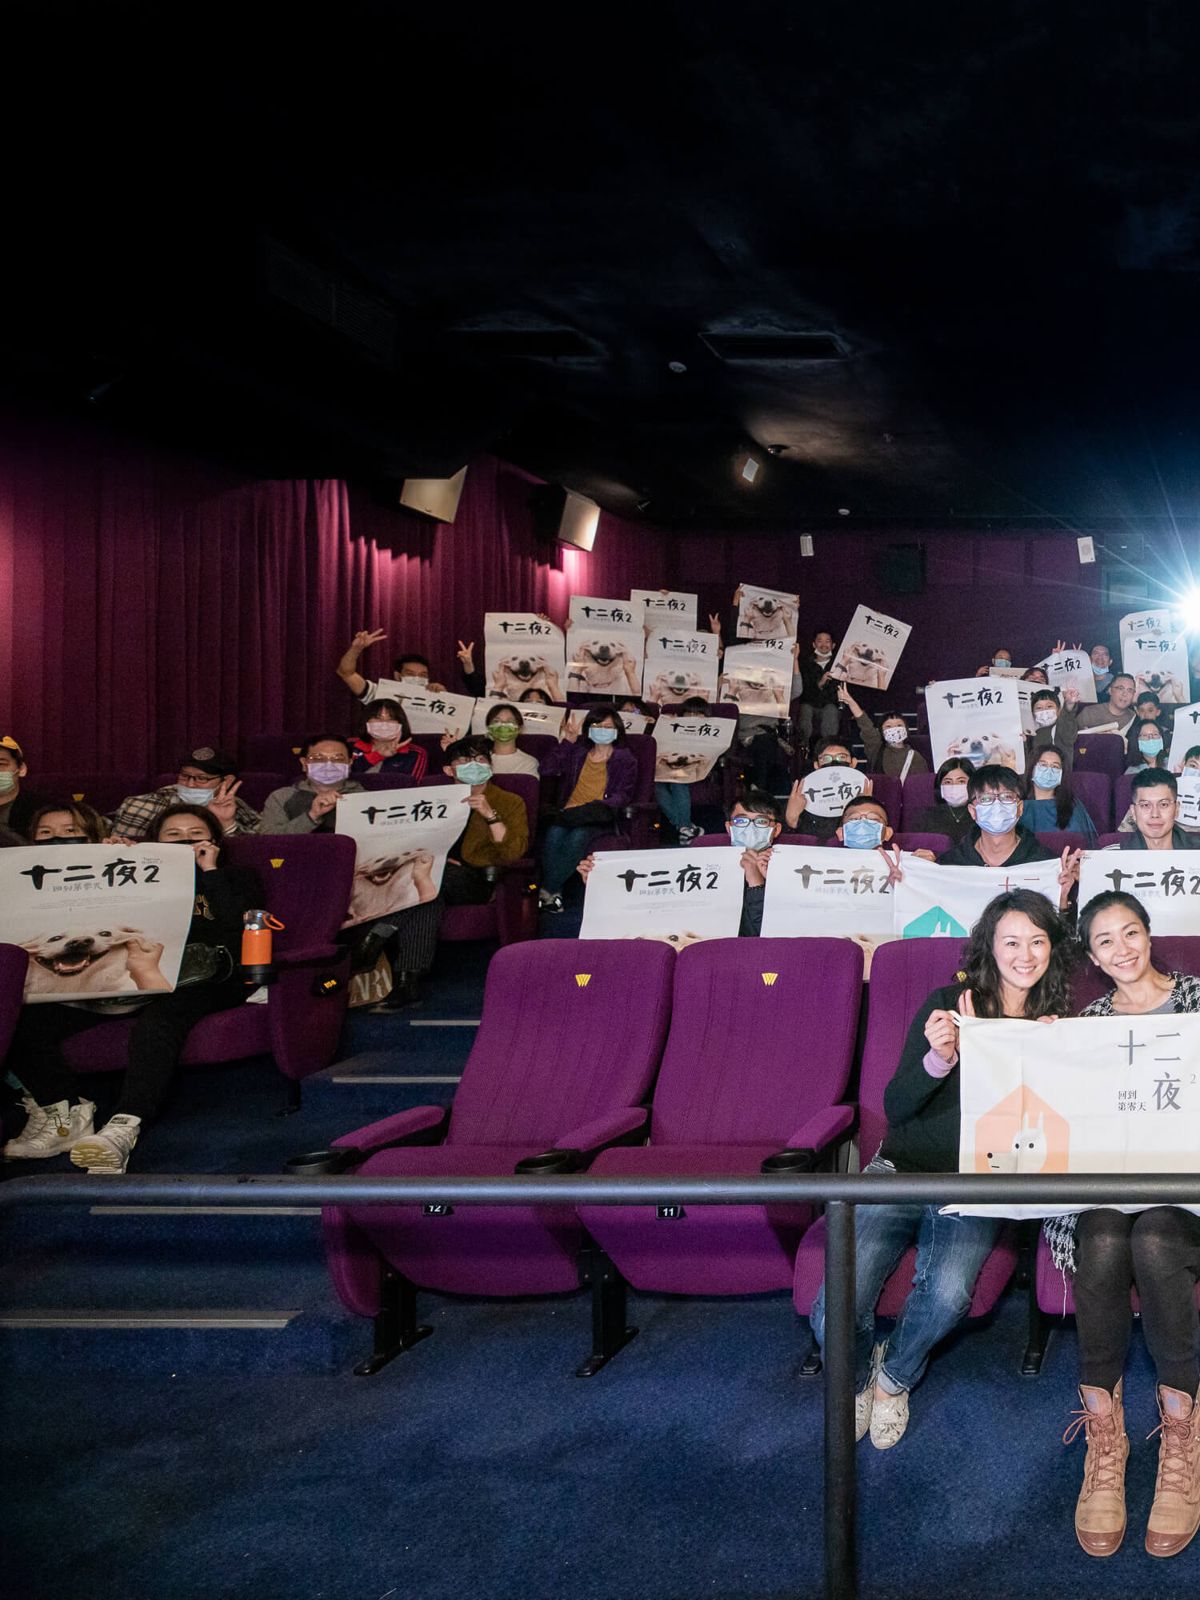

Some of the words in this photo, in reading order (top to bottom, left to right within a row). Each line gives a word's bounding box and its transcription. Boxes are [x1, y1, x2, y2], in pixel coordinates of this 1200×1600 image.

[581, 605, 633, 624] 十二夜2
[642, 597, 687, 612] 十二夜2
[498, 620, 552, 637] 十二夜2
[865, 615, 900, 639] 十二夜2
[658, 636, 707, 654] 十二夜2
[942, 687, 1003, 708] 十二夜2
[670, 722, 721, 738] 十二夜2
[361, 800, 448, 824] 十二夜2
[20, 858, 160, 890] 十二夜2
[616, 864, 718, 893] 十二夜2
[794, 864, 890, 895] 十二夜2
[663, 1207, 673, 1217] 11
